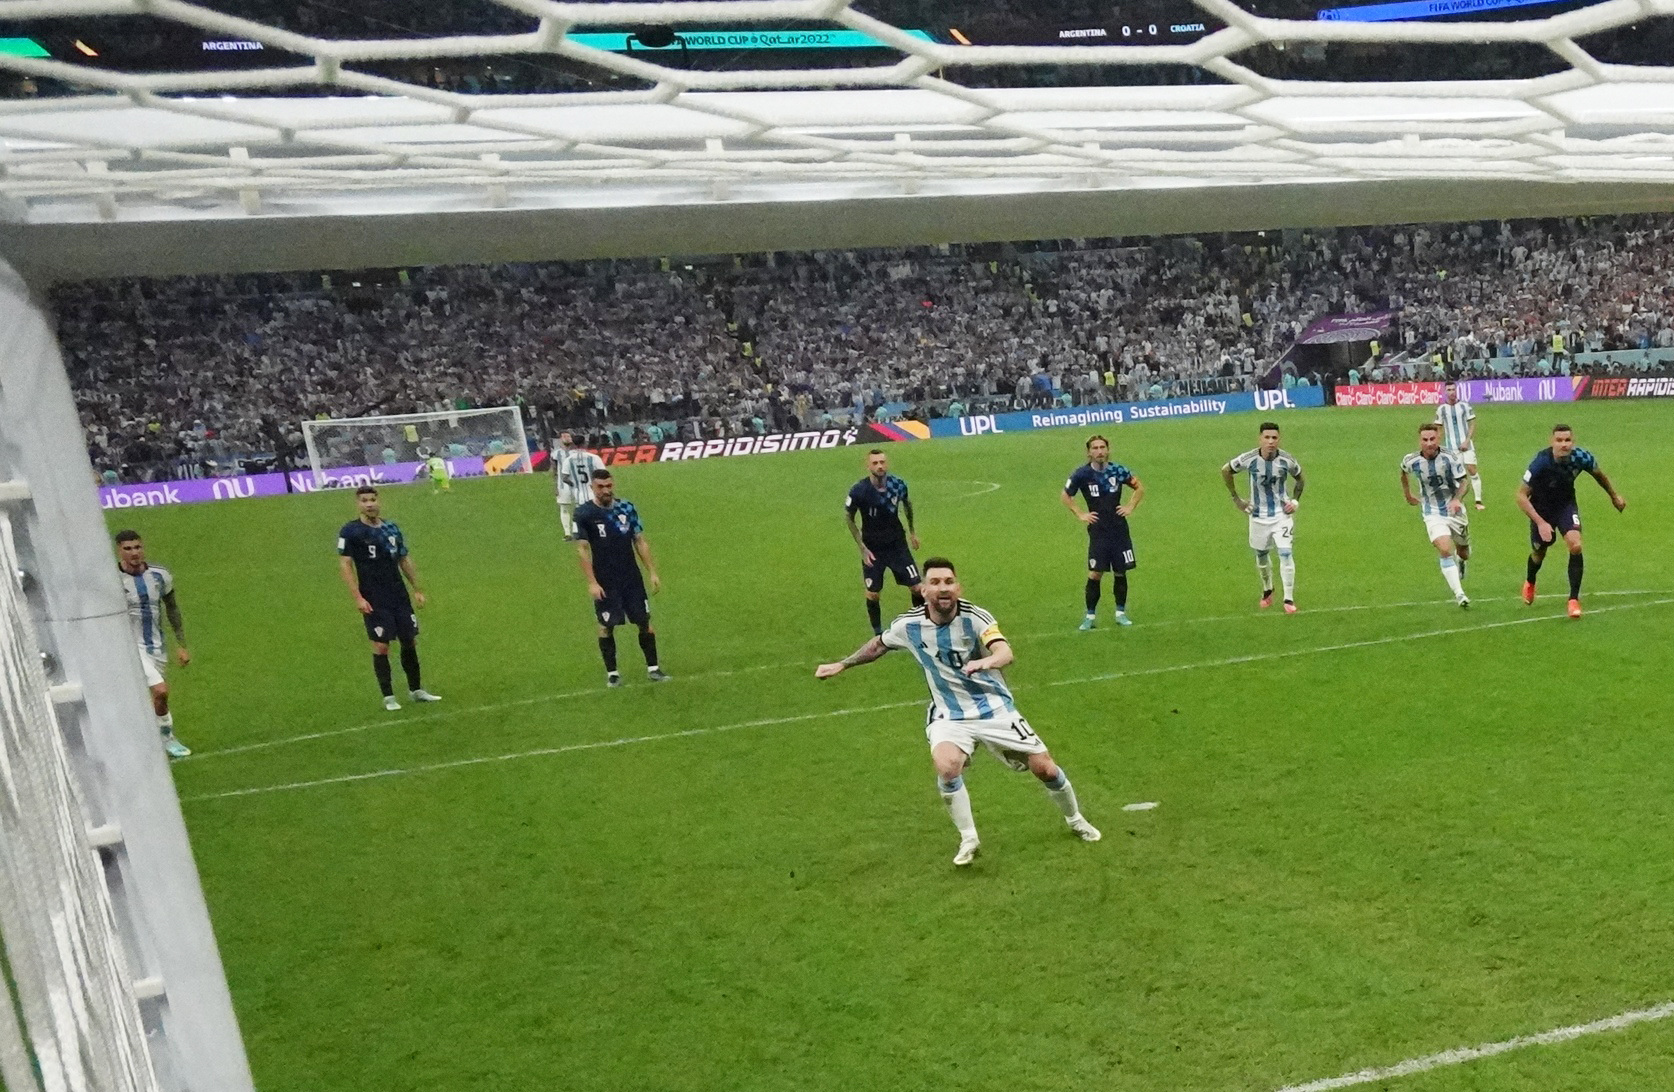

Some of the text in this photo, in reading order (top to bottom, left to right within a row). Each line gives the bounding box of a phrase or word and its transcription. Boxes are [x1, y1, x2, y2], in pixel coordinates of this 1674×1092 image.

[1429, 3, 1450, 12] FIFA
[1059, 29, 1107, 38] ARGENTINA
[1122, 26, 1131, 36] 0
[1149, 25, 1157, 35] 0
[1170, 23, 1205, 33] CROATIA
[202, 42, 264, 50] ARGENTINA
[685, 36, 726, 45] WORLD
[727, 35, 749, 45] CUP
[1485, 381, 1523, 402] Nubank
[1031, 407, 1123, 428] Reimagining
[1130, 398, 1227, 420] Sustainability
[577, 464, 589, 484] 5
[102, 484, 182, 509] ubank
[1572, 513, 1580, 526] 6
[368, 545, 377, 558] 9
[1122, 549, 1134, 564] 10
[906, 564, 918, 579] 11
